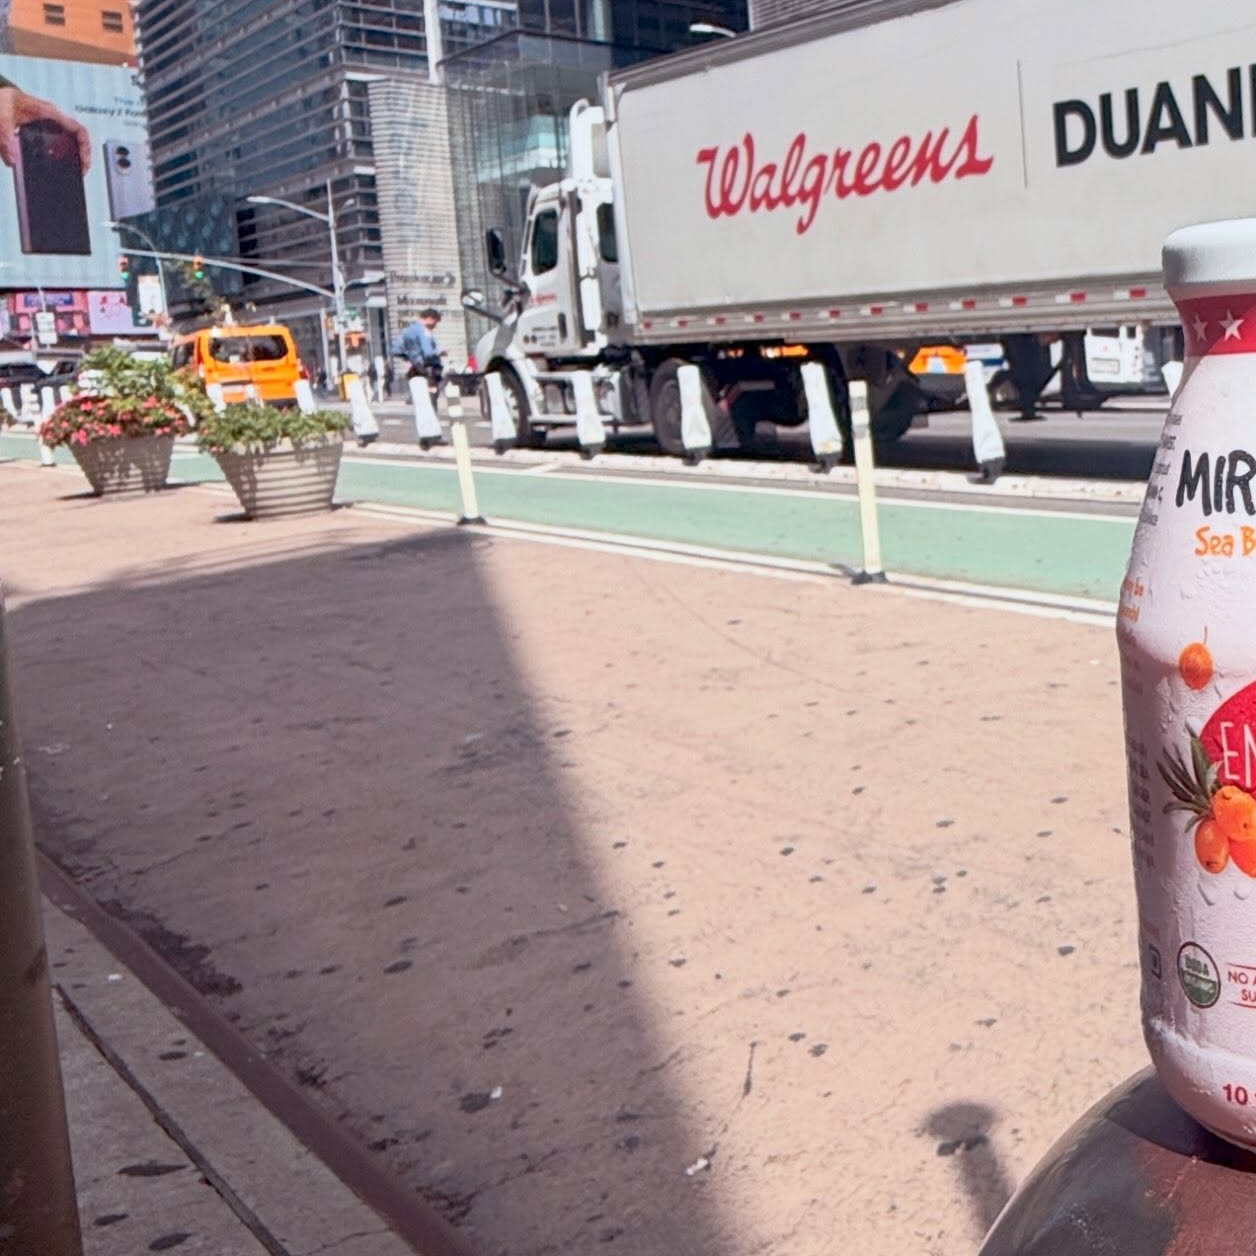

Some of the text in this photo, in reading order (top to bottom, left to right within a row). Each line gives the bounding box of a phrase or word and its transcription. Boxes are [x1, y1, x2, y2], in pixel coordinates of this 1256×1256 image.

[697, 115, 993, 234] Walgreens
[1195, 526, 1235, 557] Sea
[1228, 970, 1249, 985] NO
[1223, 1084, 1248, 1105] 10
